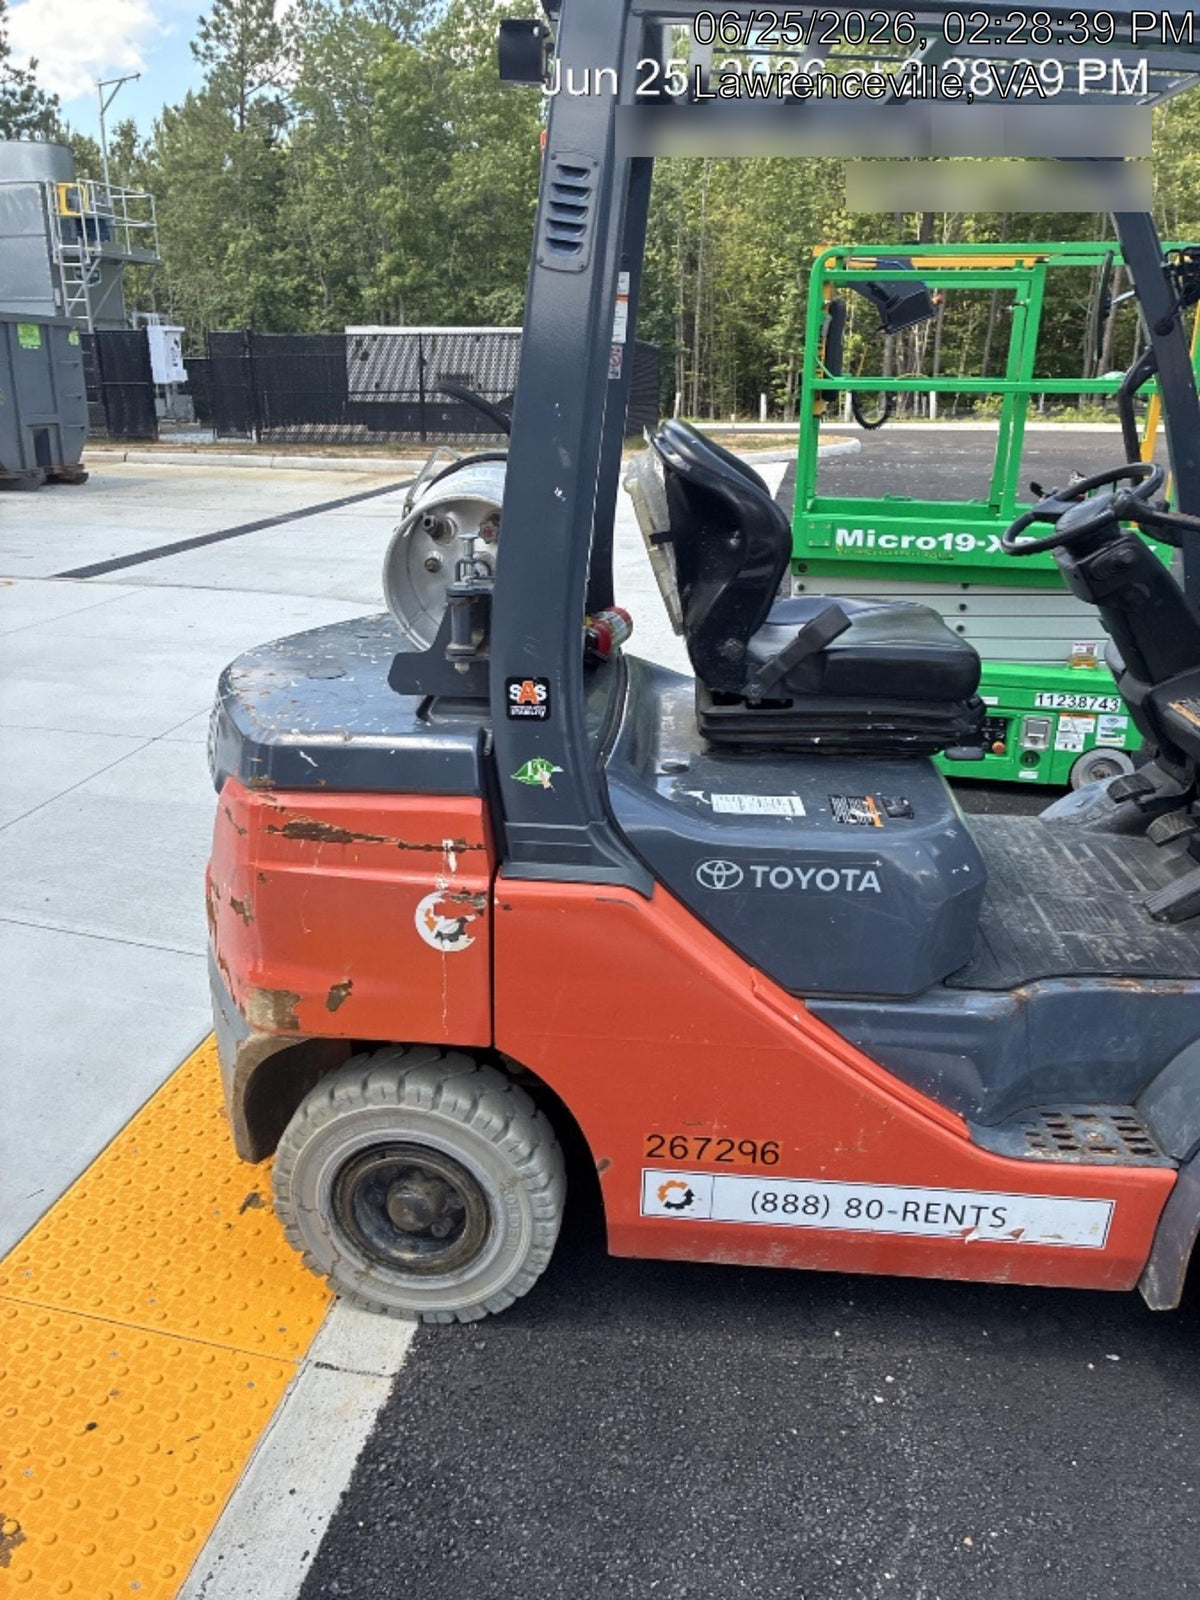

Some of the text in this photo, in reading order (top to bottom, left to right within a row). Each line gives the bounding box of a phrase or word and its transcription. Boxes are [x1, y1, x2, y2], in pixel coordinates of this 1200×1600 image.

[509, 680, 547, 704] SAS
[1037, 693, 1119, 712] 11238743
[749, 865, 881, 893] TOYOTA
[646, 1133, 780, 1165] 267296
[751, 1190, 1008, 1229] (888) 80-RENTS
